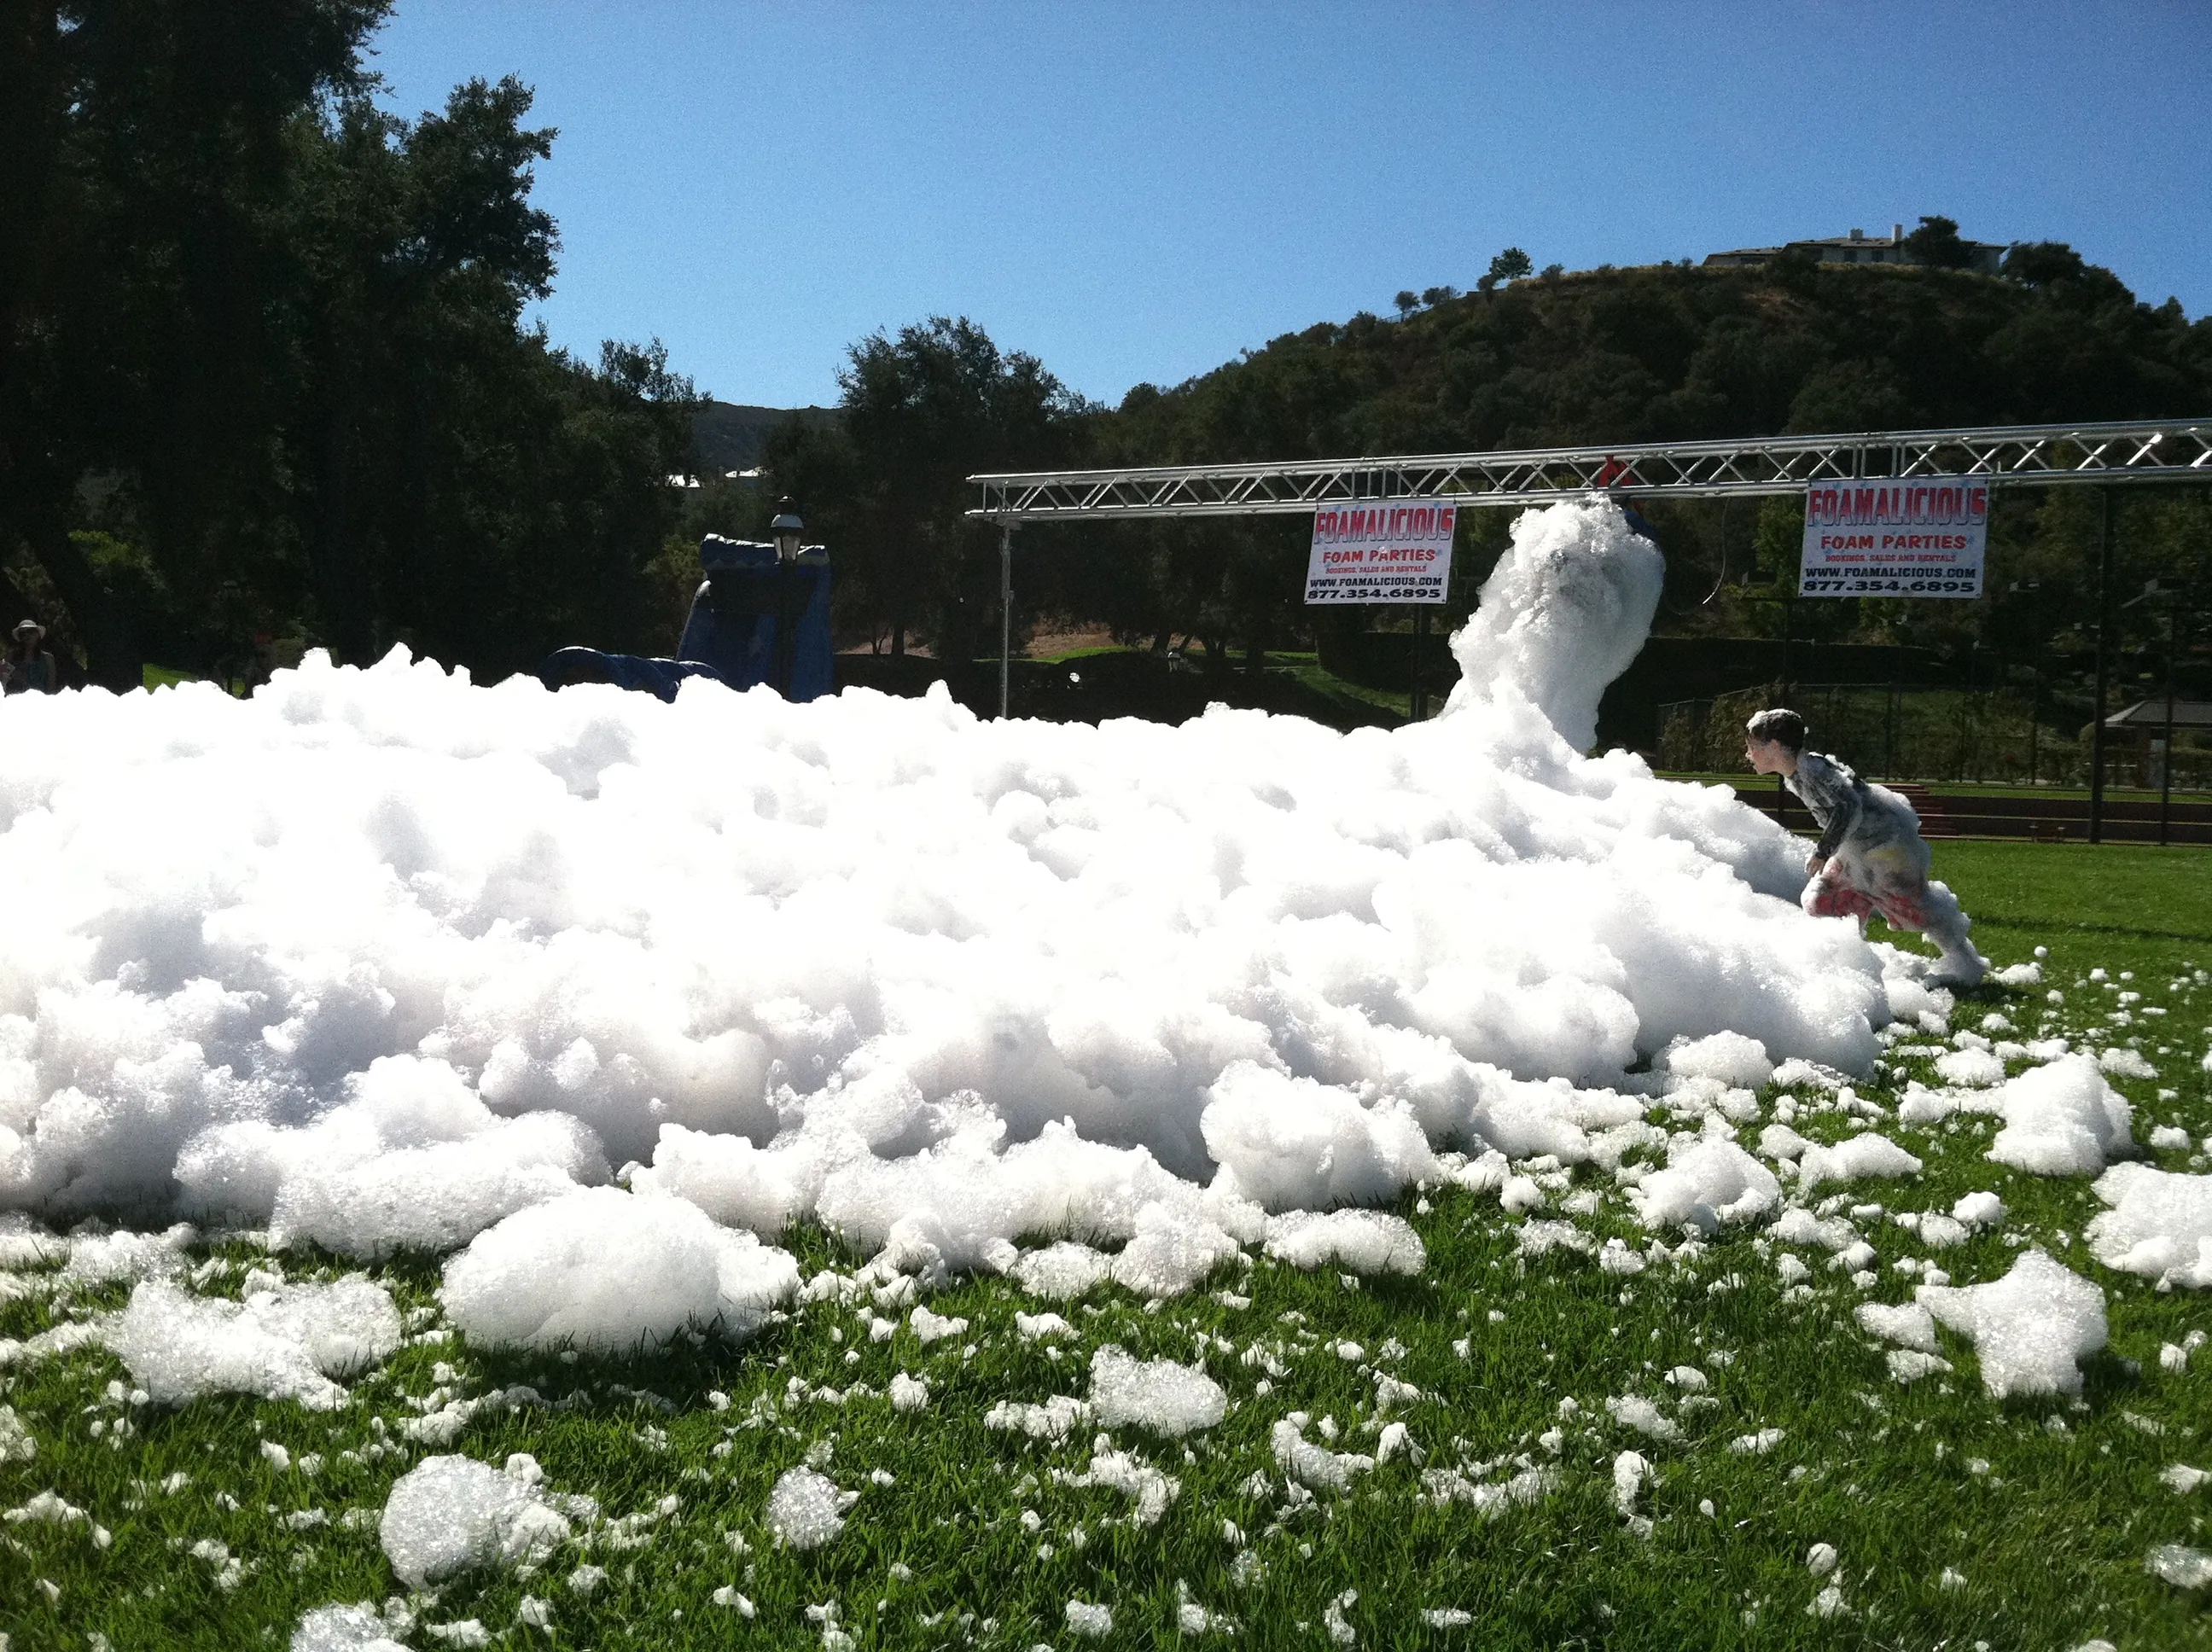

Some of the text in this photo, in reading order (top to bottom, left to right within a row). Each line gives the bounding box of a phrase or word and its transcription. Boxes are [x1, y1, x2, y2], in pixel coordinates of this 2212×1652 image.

[1807, 488, 1988, 526] FOAMALICIOUS
[1314, 508, 1454, 544] FOAMALICIOUS
[1821, 536, 1966, 549] FOAM PARTIES
[1323, 550, 1435, 563] FOAM PARTIES
[1806, 568, 1976, 578] WWW.FOAMALICIOUS.COM
[1310, 577, 1442, 587] WWW.FOAMALICIOUS.COM
[1803, 580, 1975, 592] 877.354.6895
[1307, 589, 1440, 599] 877.354.6895
